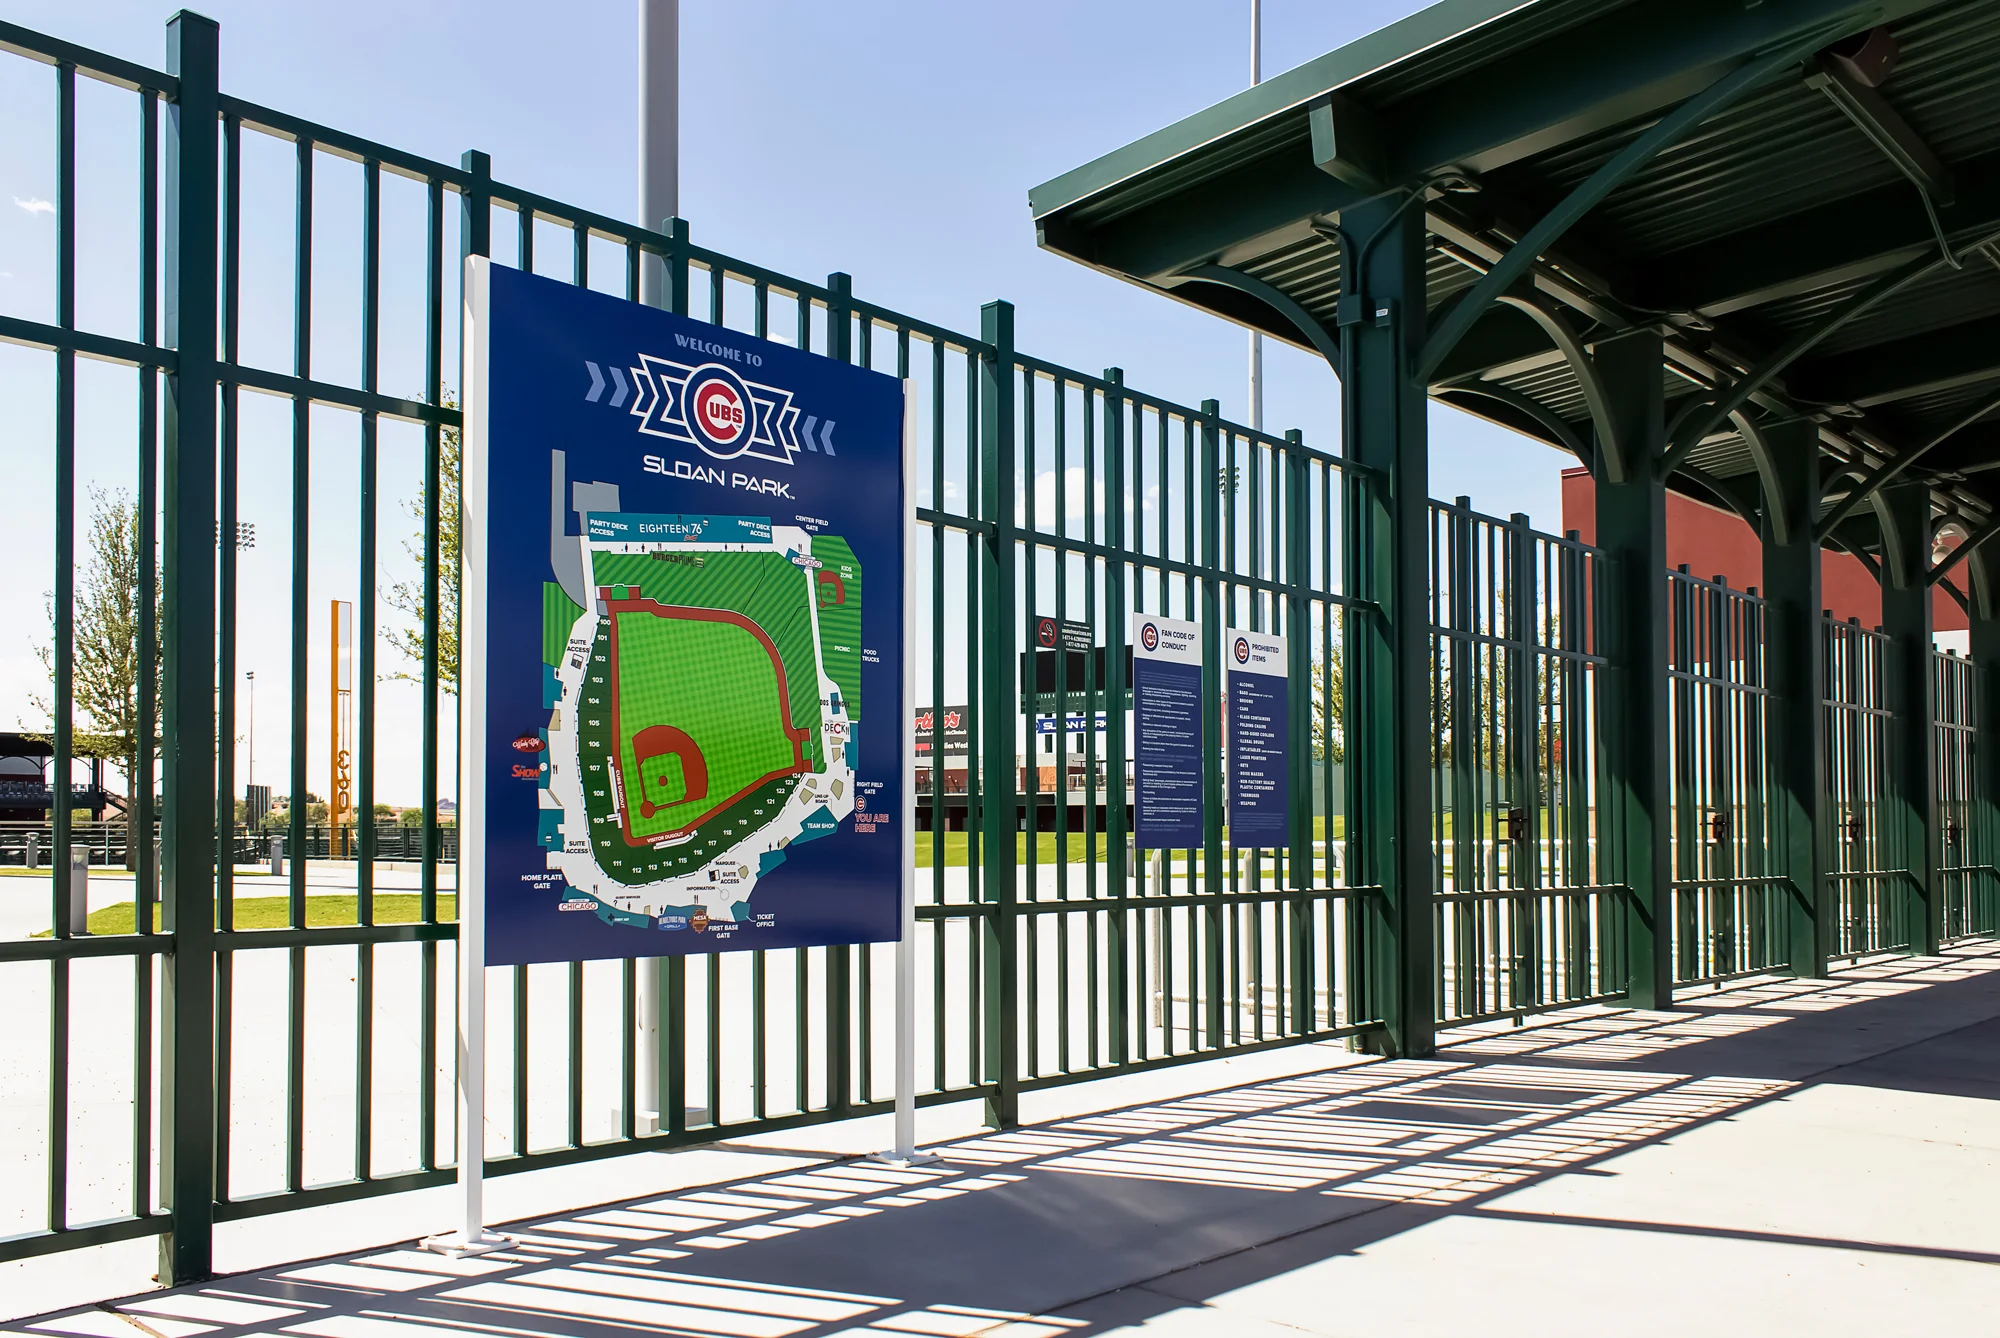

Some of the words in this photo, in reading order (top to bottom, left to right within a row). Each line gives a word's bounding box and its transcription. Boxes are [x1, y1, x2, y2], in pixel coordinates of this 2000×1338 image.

[674, 333, 742, 362] WELCOME
[745, 352, 763, 367] TO
[697, 383, 743, 440] CUBS
[643, 454, 725, 486] SLOAN
[732, 472, 790, 499] PARK
[590, 519, 610, 528] PARTY
[611, 523, 628, 531] DECK
[738, 520, 755, 529] PARTY
[756, 523, 770, 531] DECK
[795, 515, 814, 524] CENTER
[815, 518, 829, 526] FIELD
[590, 527, 615, 537] ACCESS
[639, 523, 689, 534] EIGHTEEN
[690, 523, 703, 535] 76
[749, 530, 771, 538] ACCESS
[794, 557, 821, 568] CHICAGO
[1161, 629, 1172, 637] FAN
[1172, 631, 1187, 640] CODE
[1188, 633, 1195, 641] OF
[834, 645, 851, 653] PICNIC
[1161, 642, 1187, 651] CONDUCT
[1251, 643, 1280, 654] PROHIBITED
[1251, 654, 1266, 663] ITEMS
[824, 723, 846, 735] DECK
[1043, 721, 1078, 730] SLAN
[511, 764, 541, 778] SHOW
[854, 813, 872, 823] YOU
[873, 813, 889, 823] ARE
[854, 823, 876, 833] HERE
[665, 831, 684, 841] DUGOUT
[561, 902, 597, 910] CHICAGO
